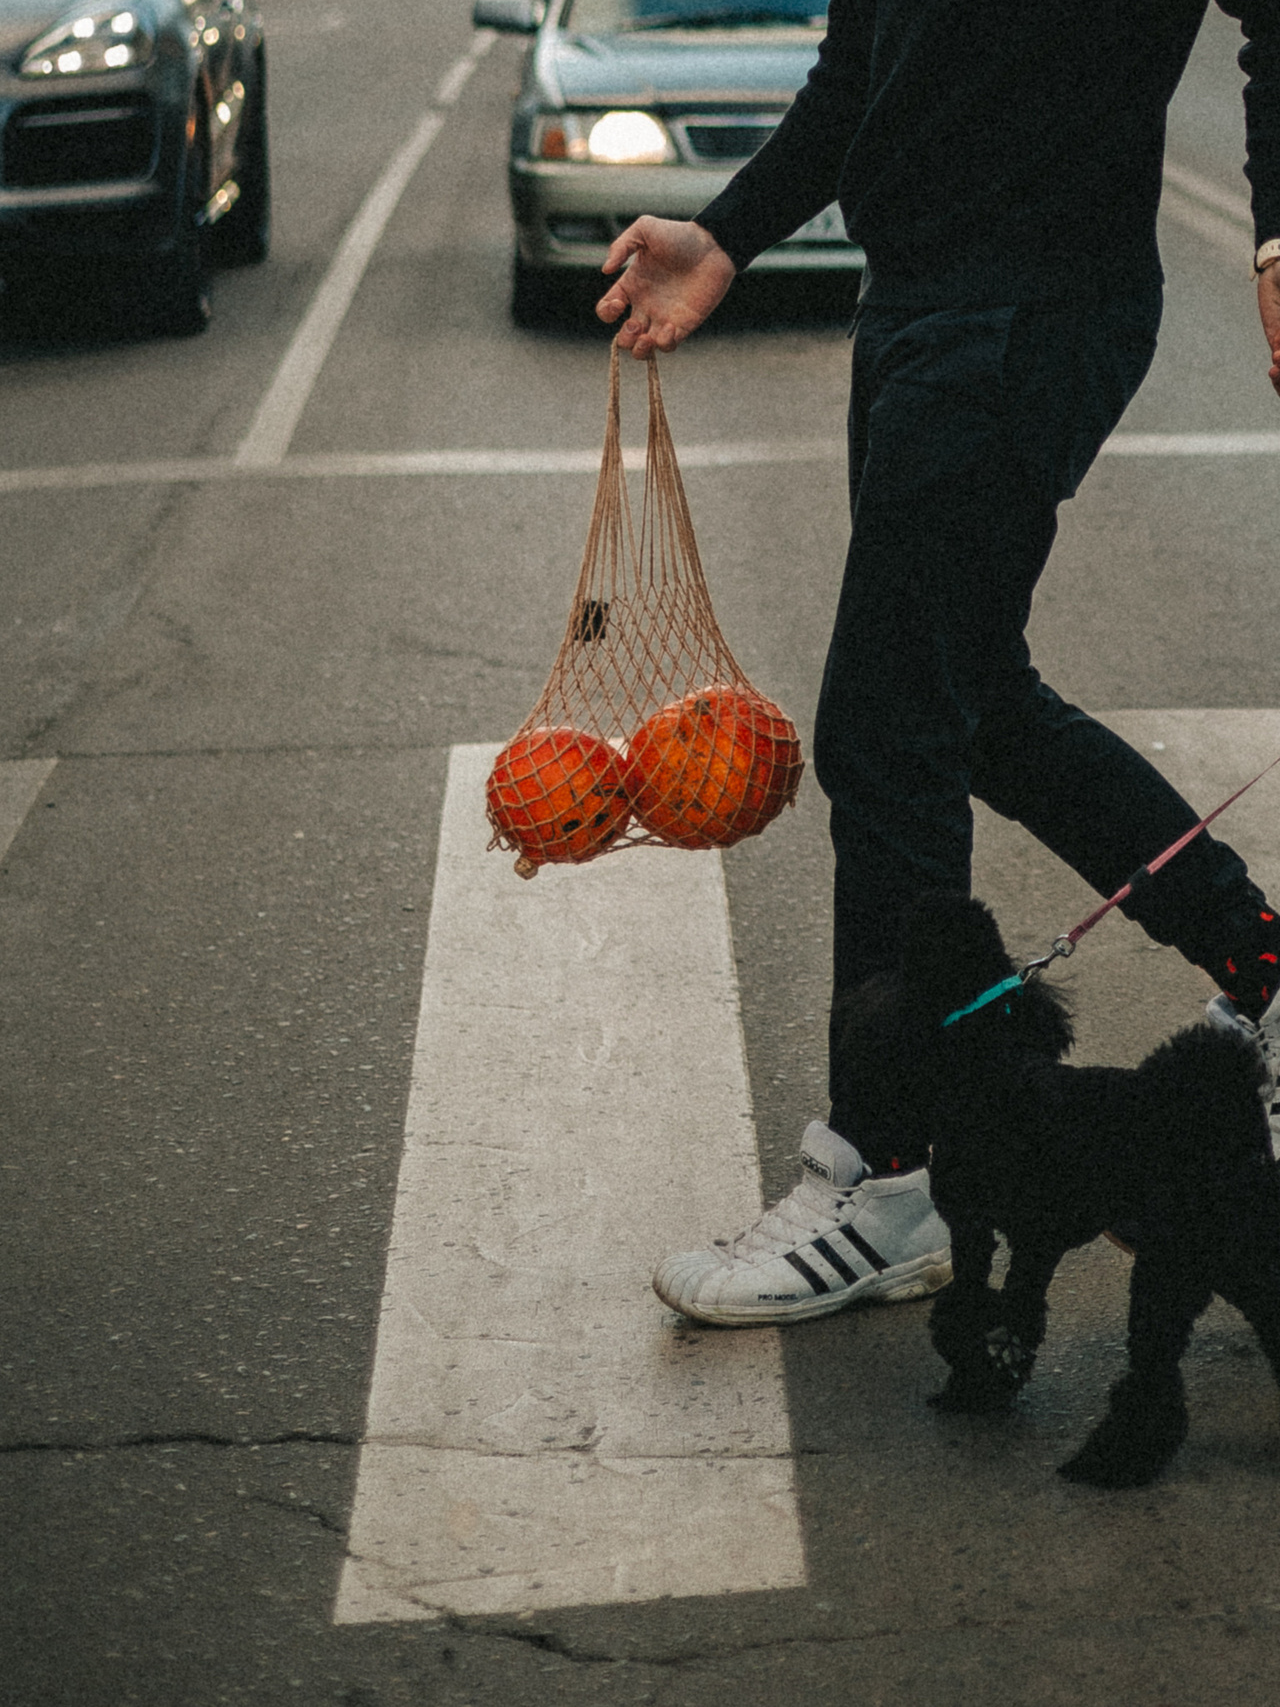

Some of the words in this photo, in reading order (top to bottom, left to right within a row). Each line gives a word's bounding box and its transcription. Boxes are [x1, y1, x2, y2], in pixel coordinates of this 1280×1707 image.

[802, 1155, 829, 1180] adidas
[758, 1293, 773, 1301] PRO
[774, 1293, 798, 1301] MODEL
